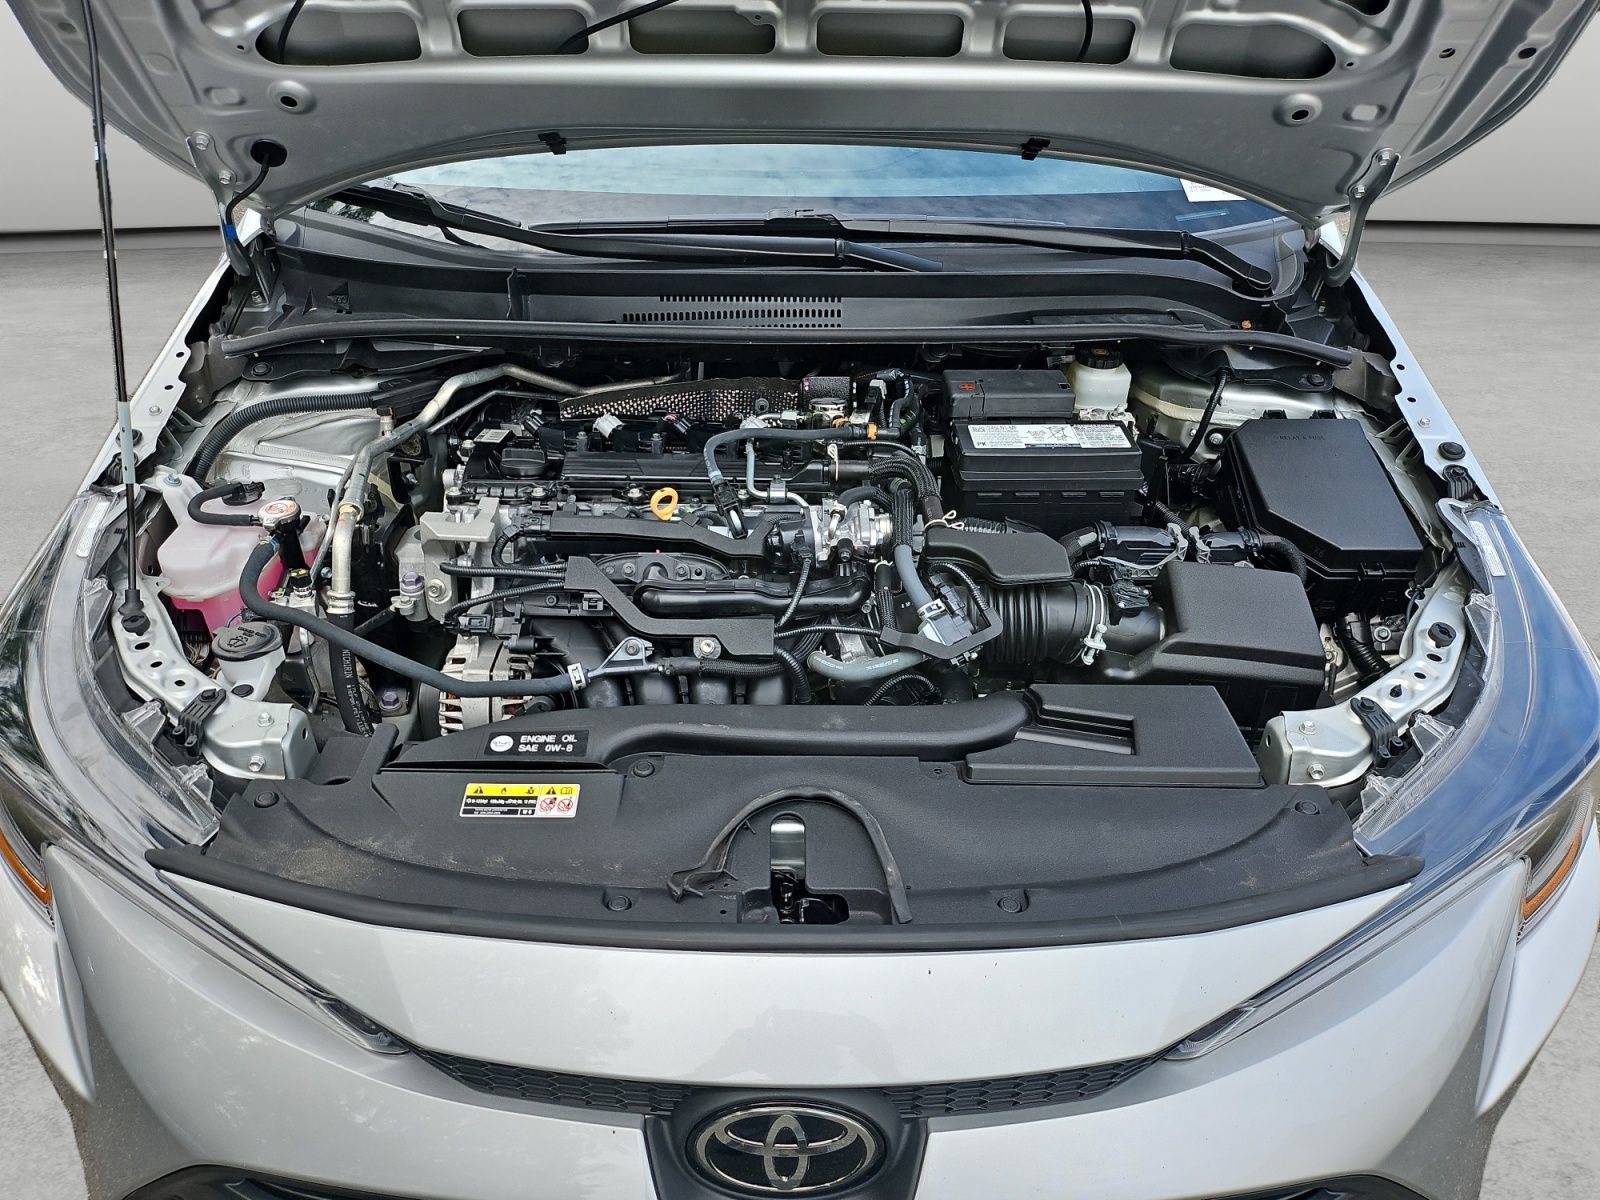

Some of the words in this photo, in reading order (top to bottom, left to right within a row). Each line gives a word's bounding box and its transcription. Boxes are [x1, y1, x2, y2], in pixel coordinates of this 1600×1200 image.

[520, 734, 556, 743] ENGINE
[561, 734, 578, 743] OIL
[518, 744, 539, 752] SAE
[545, 744, 573, 752] 0W-8
